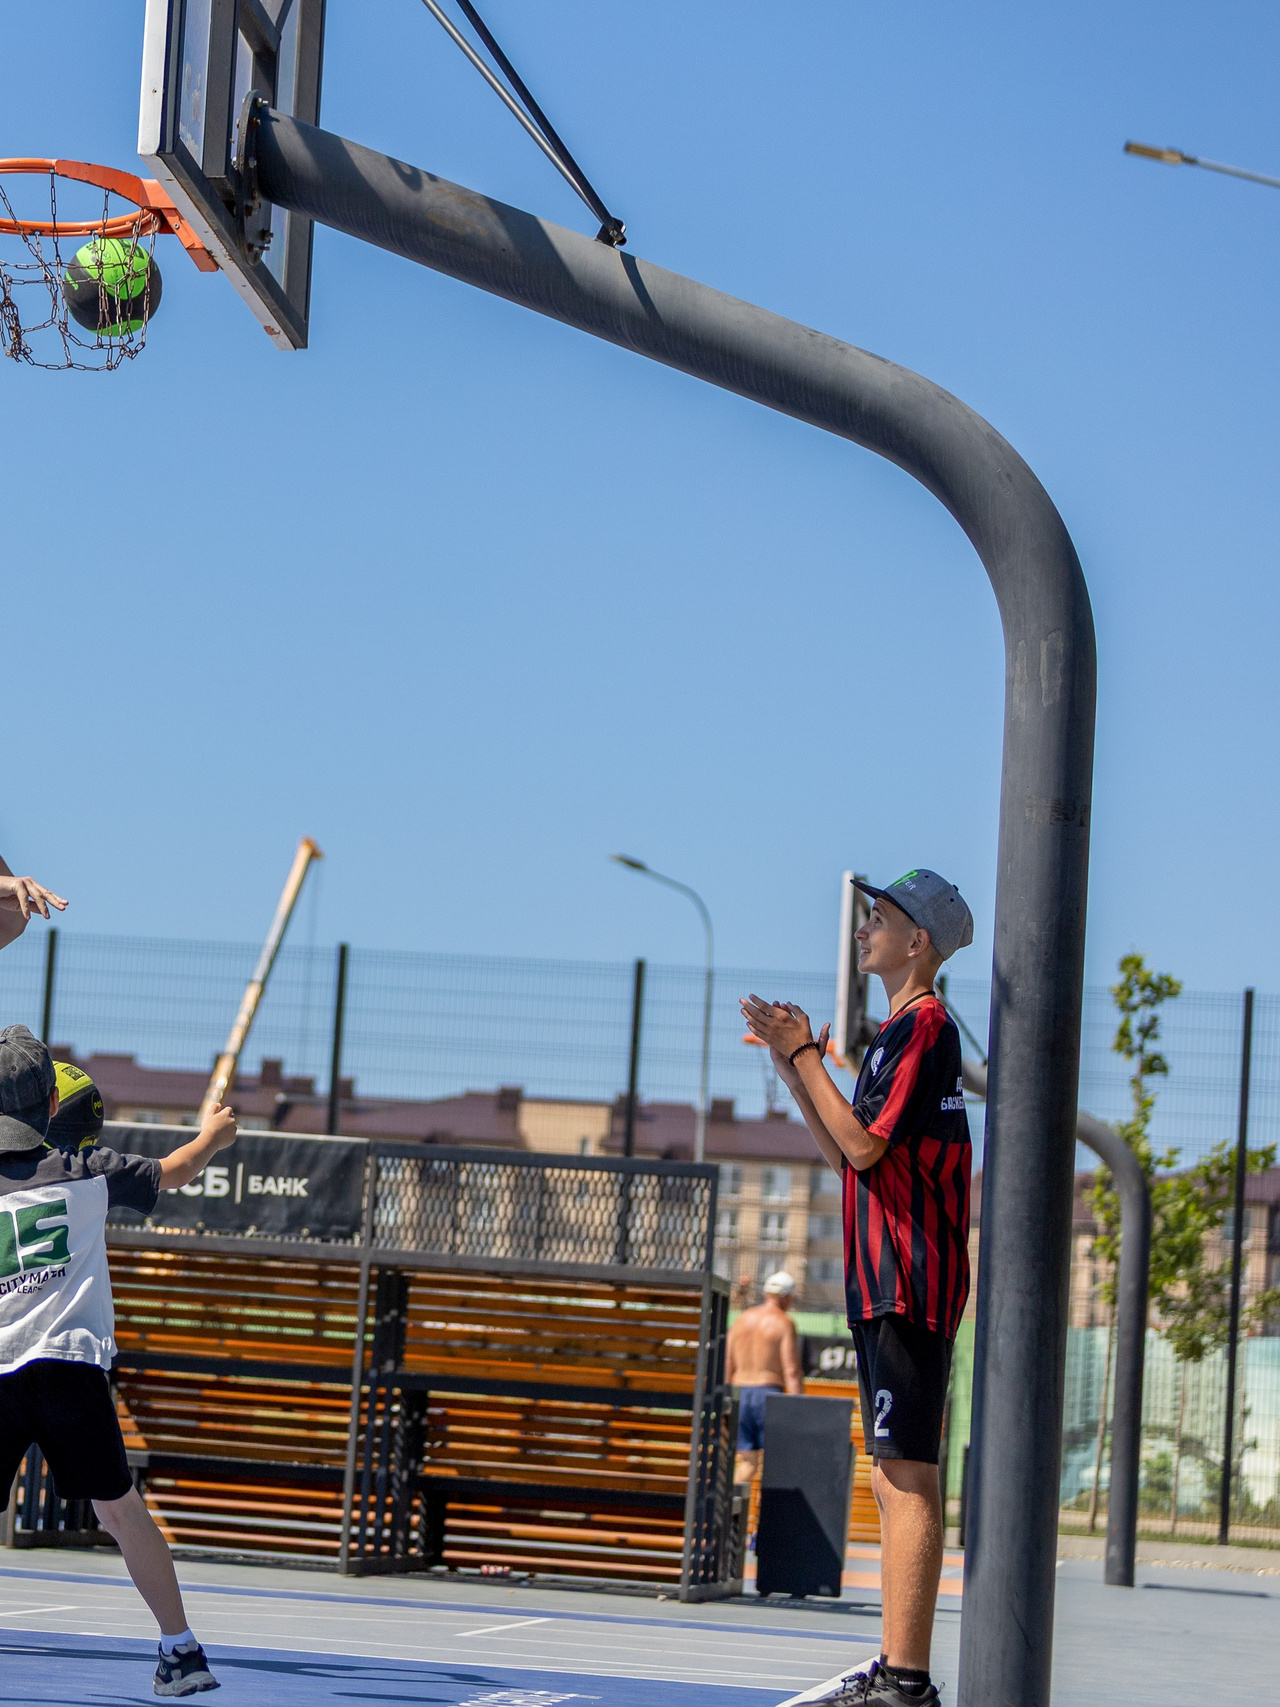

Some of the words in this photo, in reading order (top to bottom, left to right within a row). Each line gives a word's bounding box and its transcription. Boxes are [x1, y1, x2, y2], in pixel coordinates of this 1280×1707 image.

[167, 1166, 230, 1198] СБ
[248, 1175, 309, 1197] БАНК
[874, 1389, 893, 1437] 2
